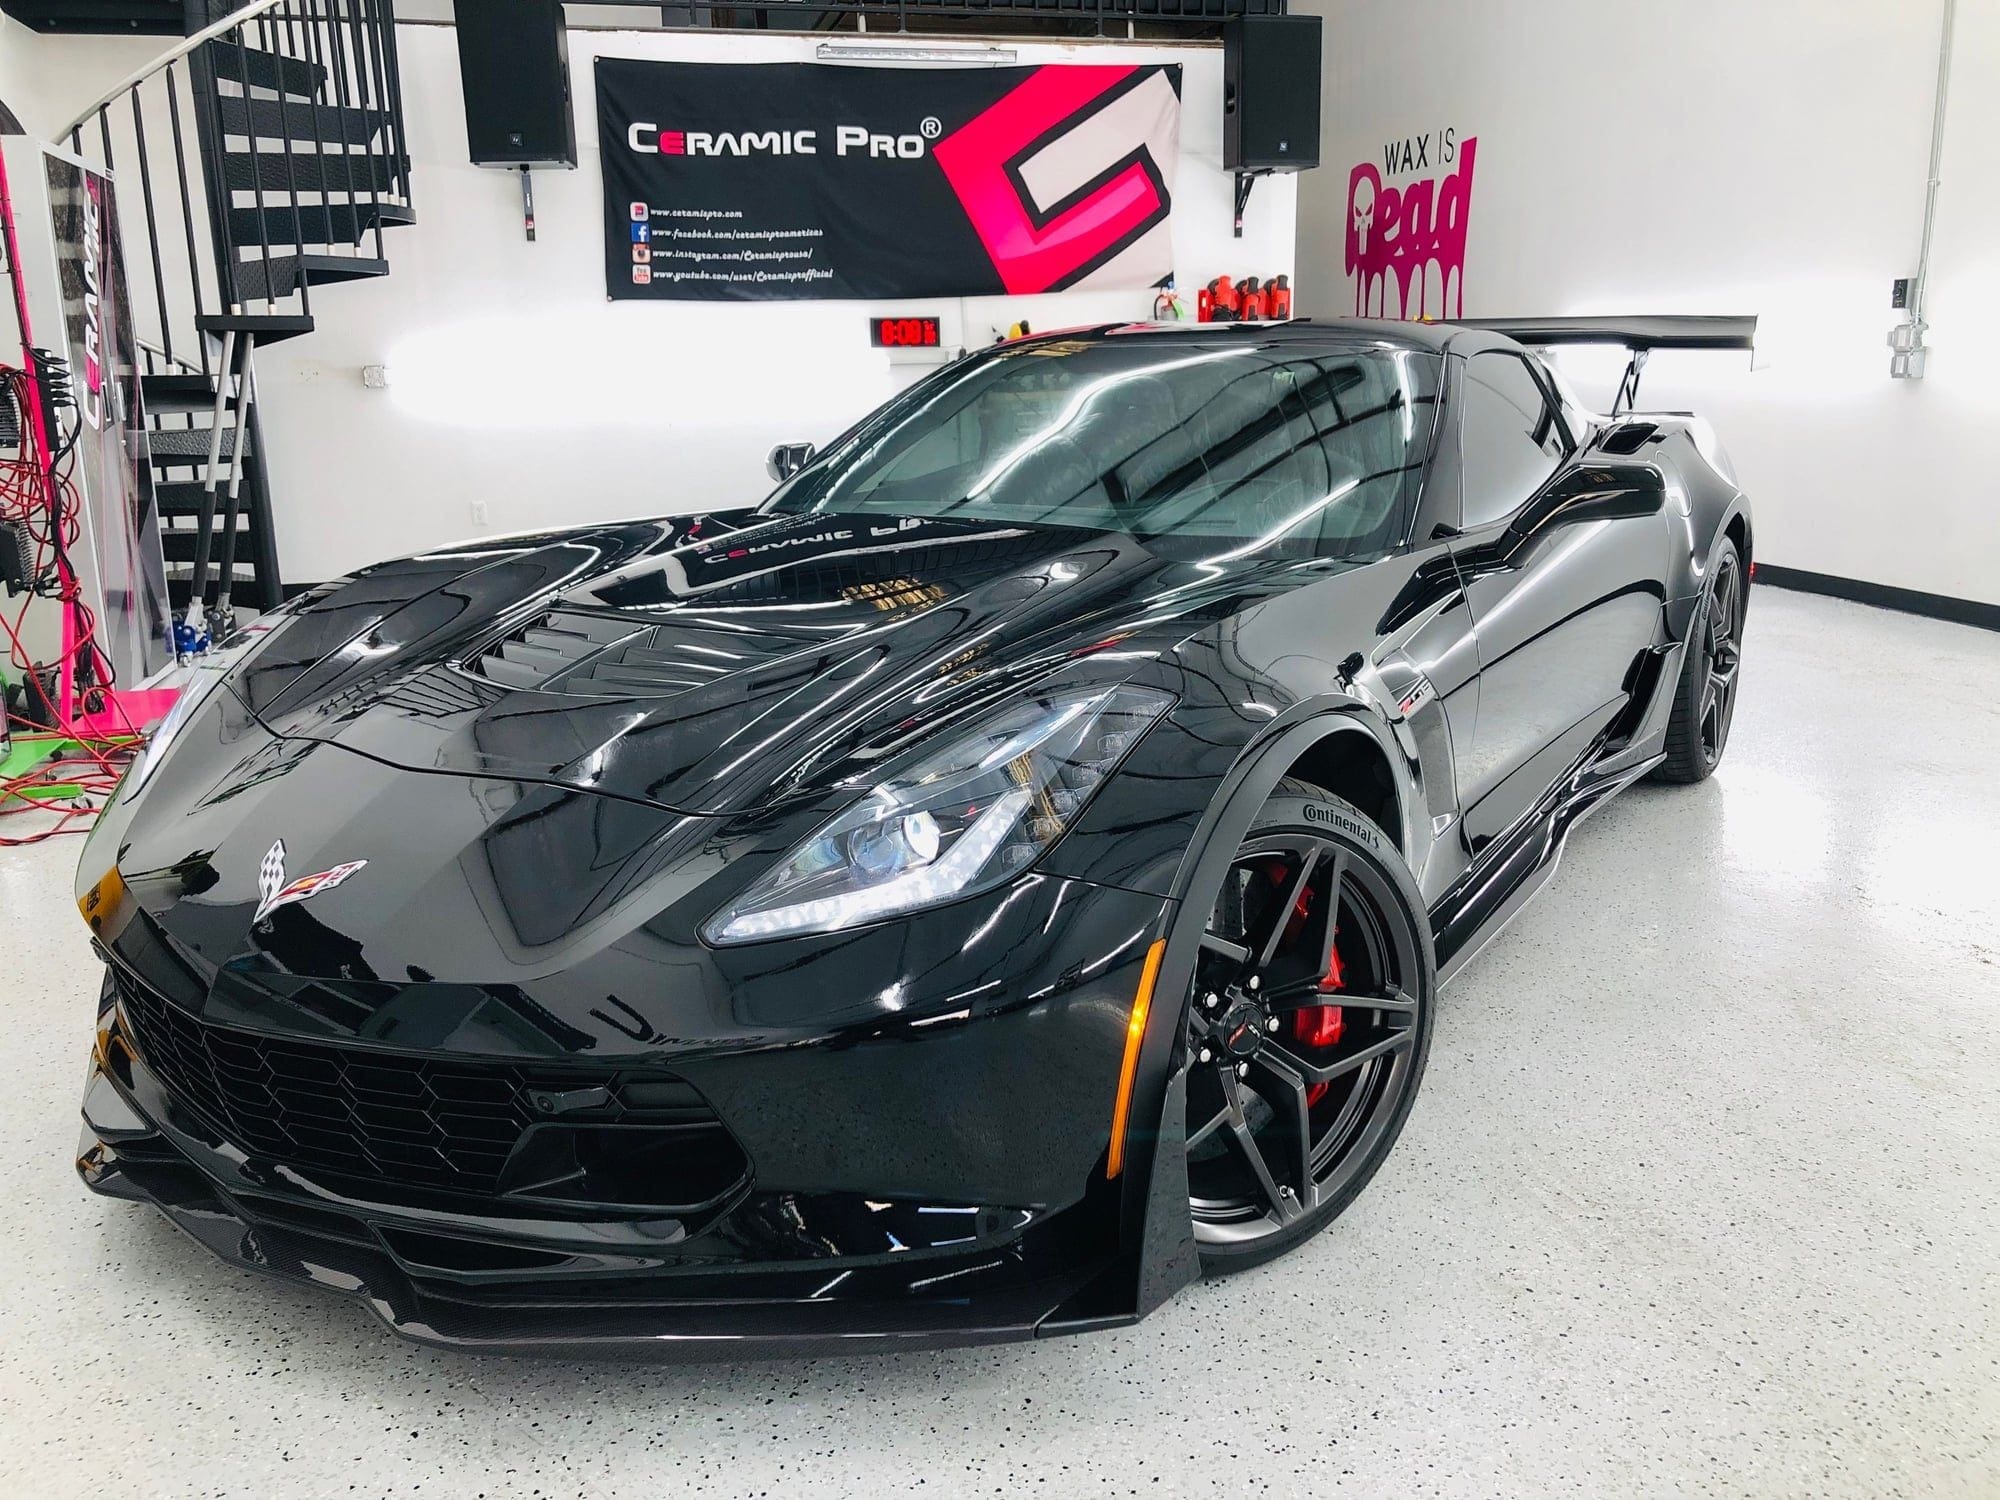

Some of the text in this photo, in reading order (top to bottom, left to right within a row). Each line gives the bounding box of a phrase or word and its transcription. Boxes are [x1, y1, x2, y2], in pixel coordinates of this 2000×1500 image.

[628, 122, 817, 156] CERAMIC
[1385, 127, 1455, 176] WAX IS
[1302, 804, 1371, 844] Continental
